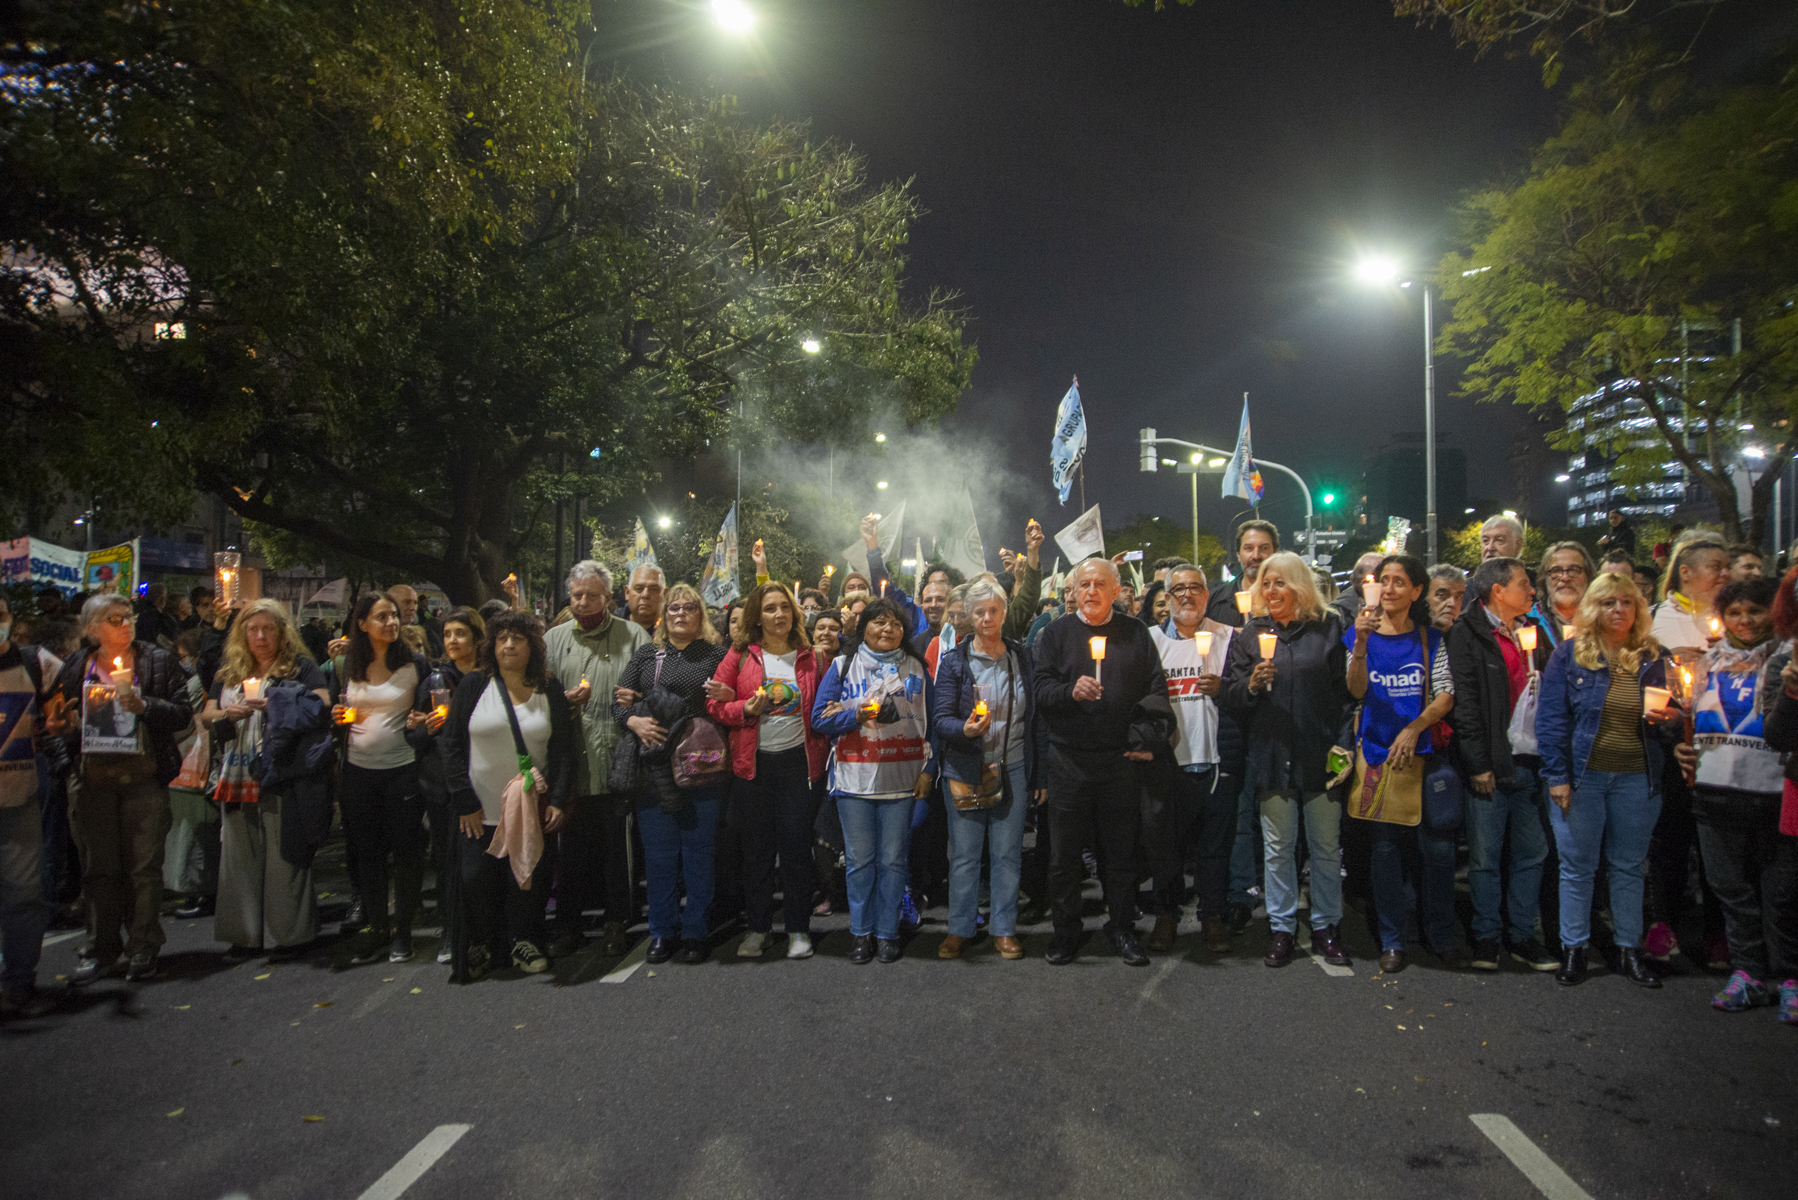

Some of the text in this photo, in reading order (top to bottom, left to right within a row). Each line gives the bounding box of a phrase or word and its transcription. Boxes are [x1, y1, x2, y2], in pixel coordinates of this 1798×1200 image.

[30, 557, 81, 582] SOCIAL
[1164, 667, 1196, 678] SANTA
[841, 677, 905, 702] Suta
[1737, 687, 1752, 702] F
[1695, 736, 1772, 752] ENTE TRANSVER
